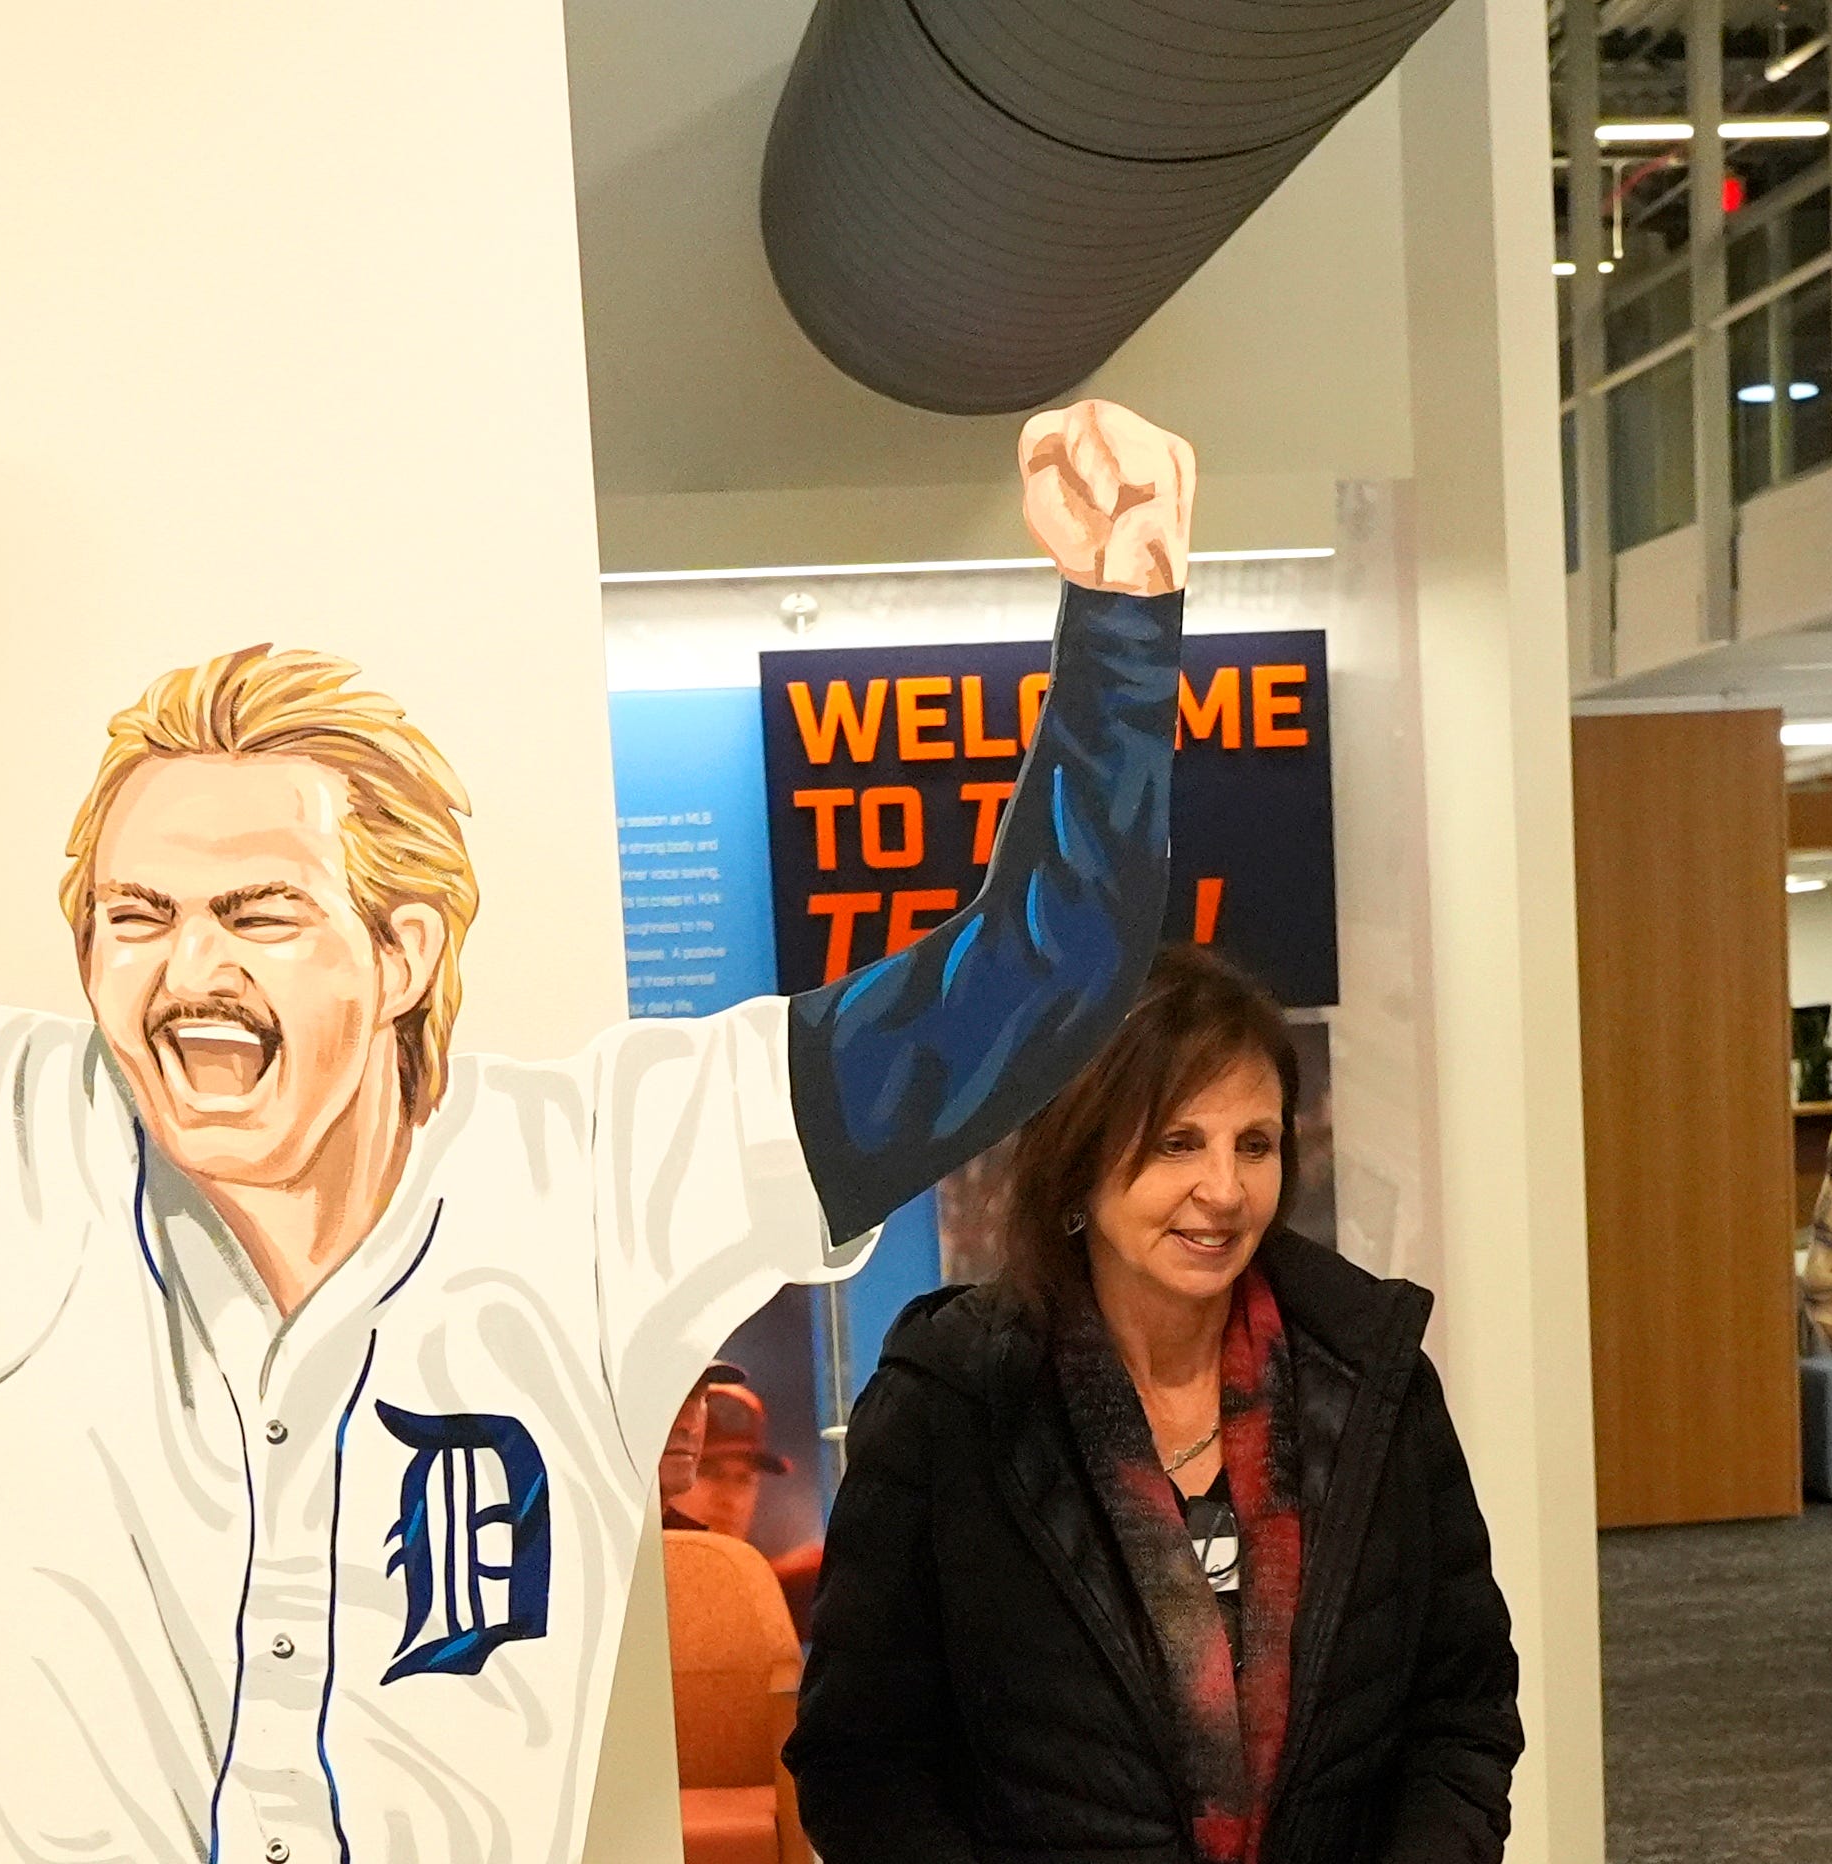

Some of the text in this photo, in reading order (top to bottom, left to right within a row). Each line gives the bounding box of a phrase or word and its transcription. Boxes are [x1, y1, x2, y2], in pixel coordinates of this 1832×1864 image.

[786, 664, 1308, 765] WELME
[793, 786, 924, 871] TO
[375, 1398, 552, 1686] D
